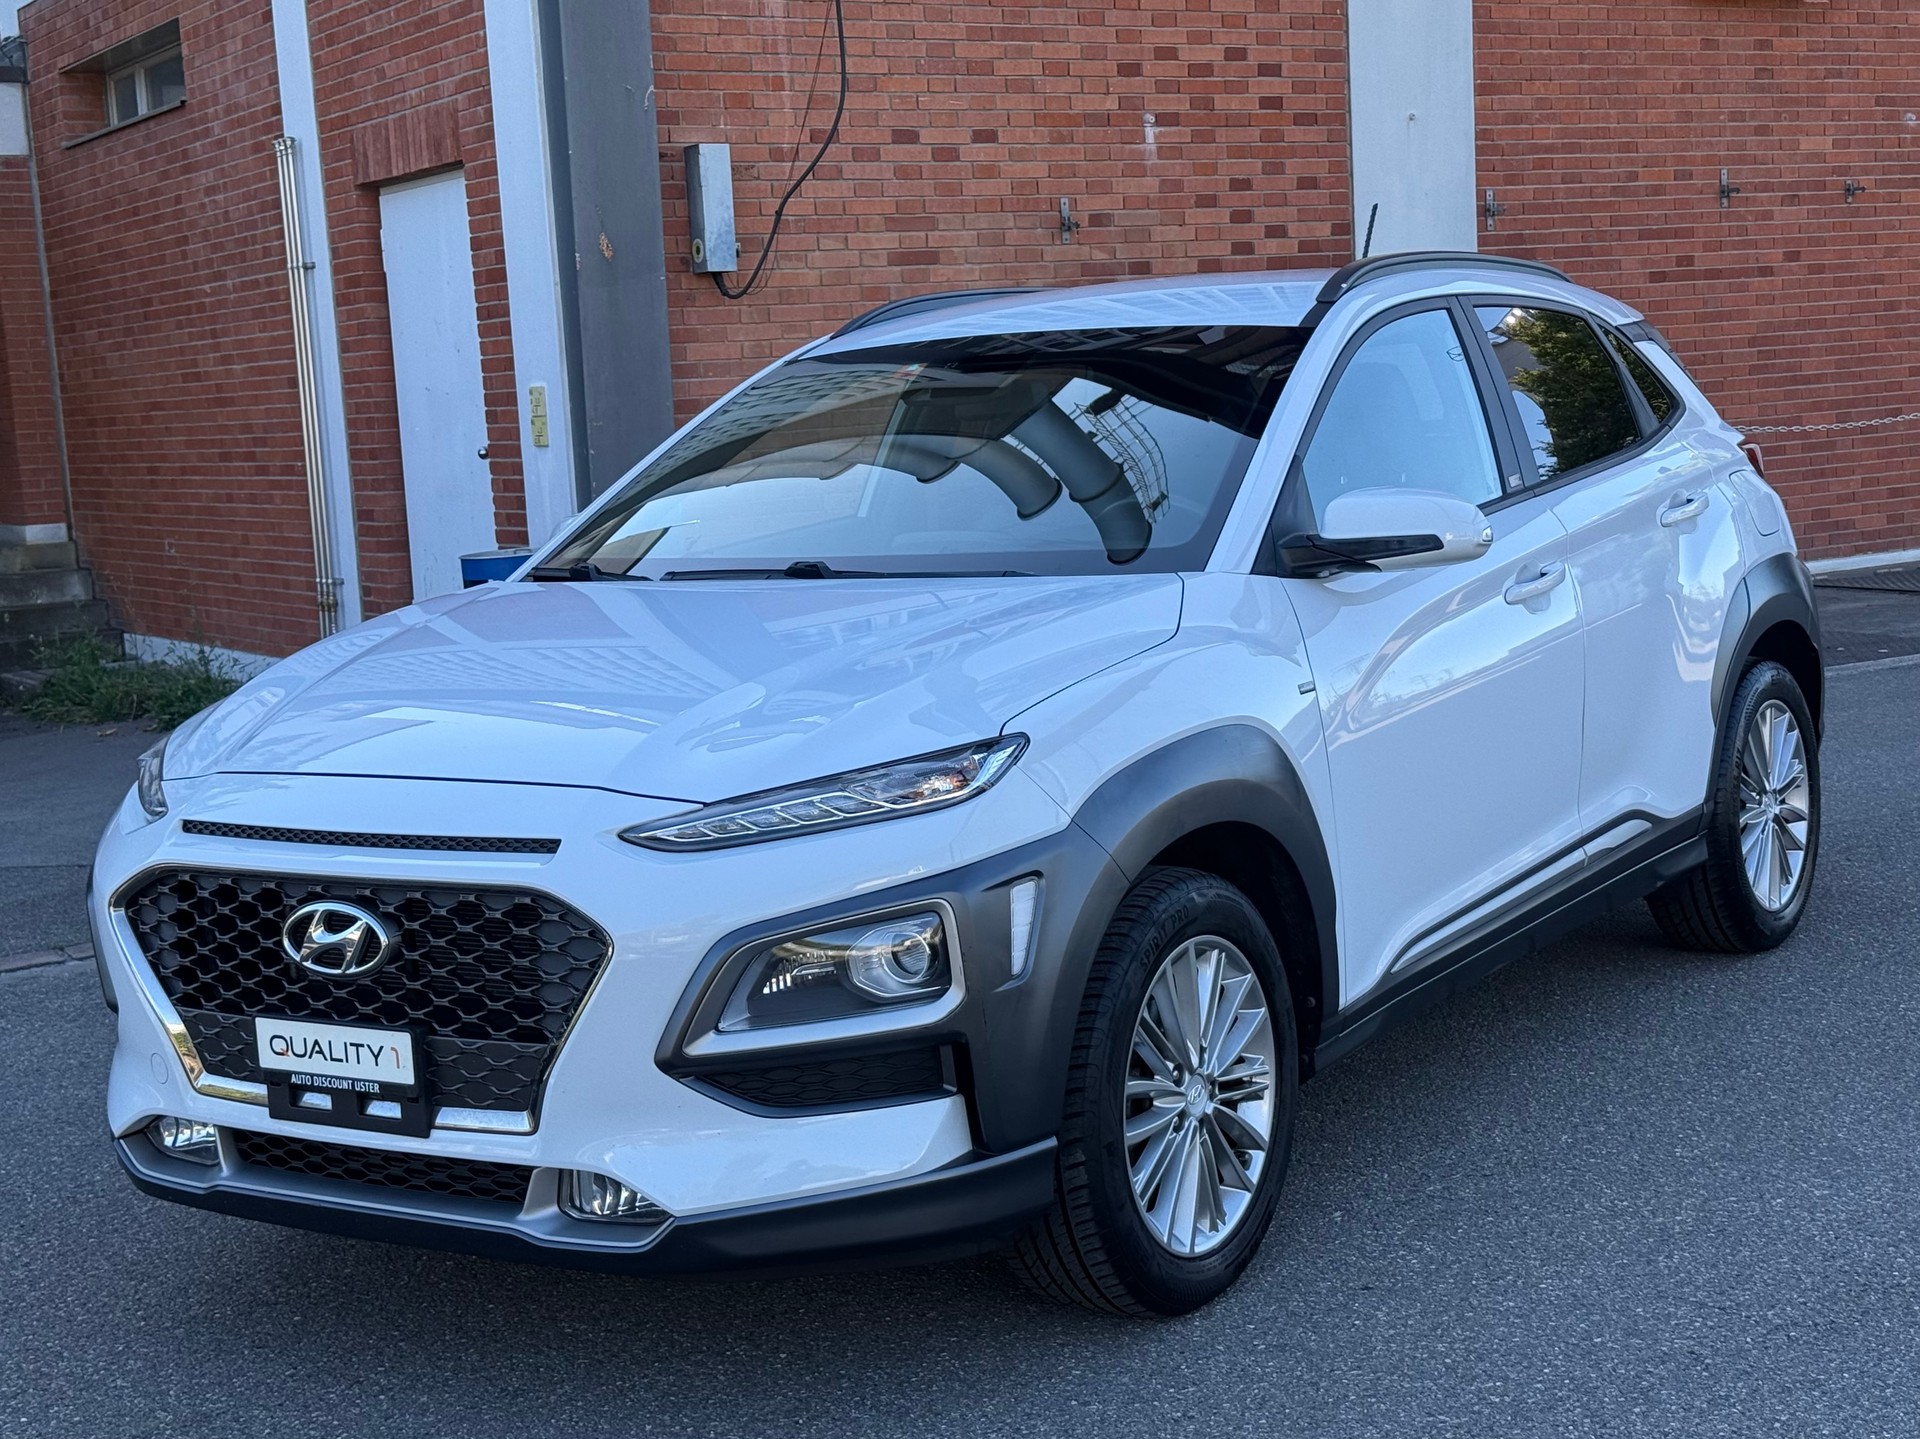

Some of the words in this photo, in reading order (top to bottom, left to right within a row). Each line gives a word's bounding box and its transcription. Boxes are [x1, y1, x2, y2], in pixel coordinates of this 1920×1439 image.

[1139, 921, 1169, 972] SPIRIT
[1170, 905, 1190, 929] PRO
[269, 1034, 384, 1066] QUALITY
[291, 1073, 312, 1086] AUTO
[313, 1076, 352, 1090] DISCOUNT
[354, 1081, 380, 1093] USTER
